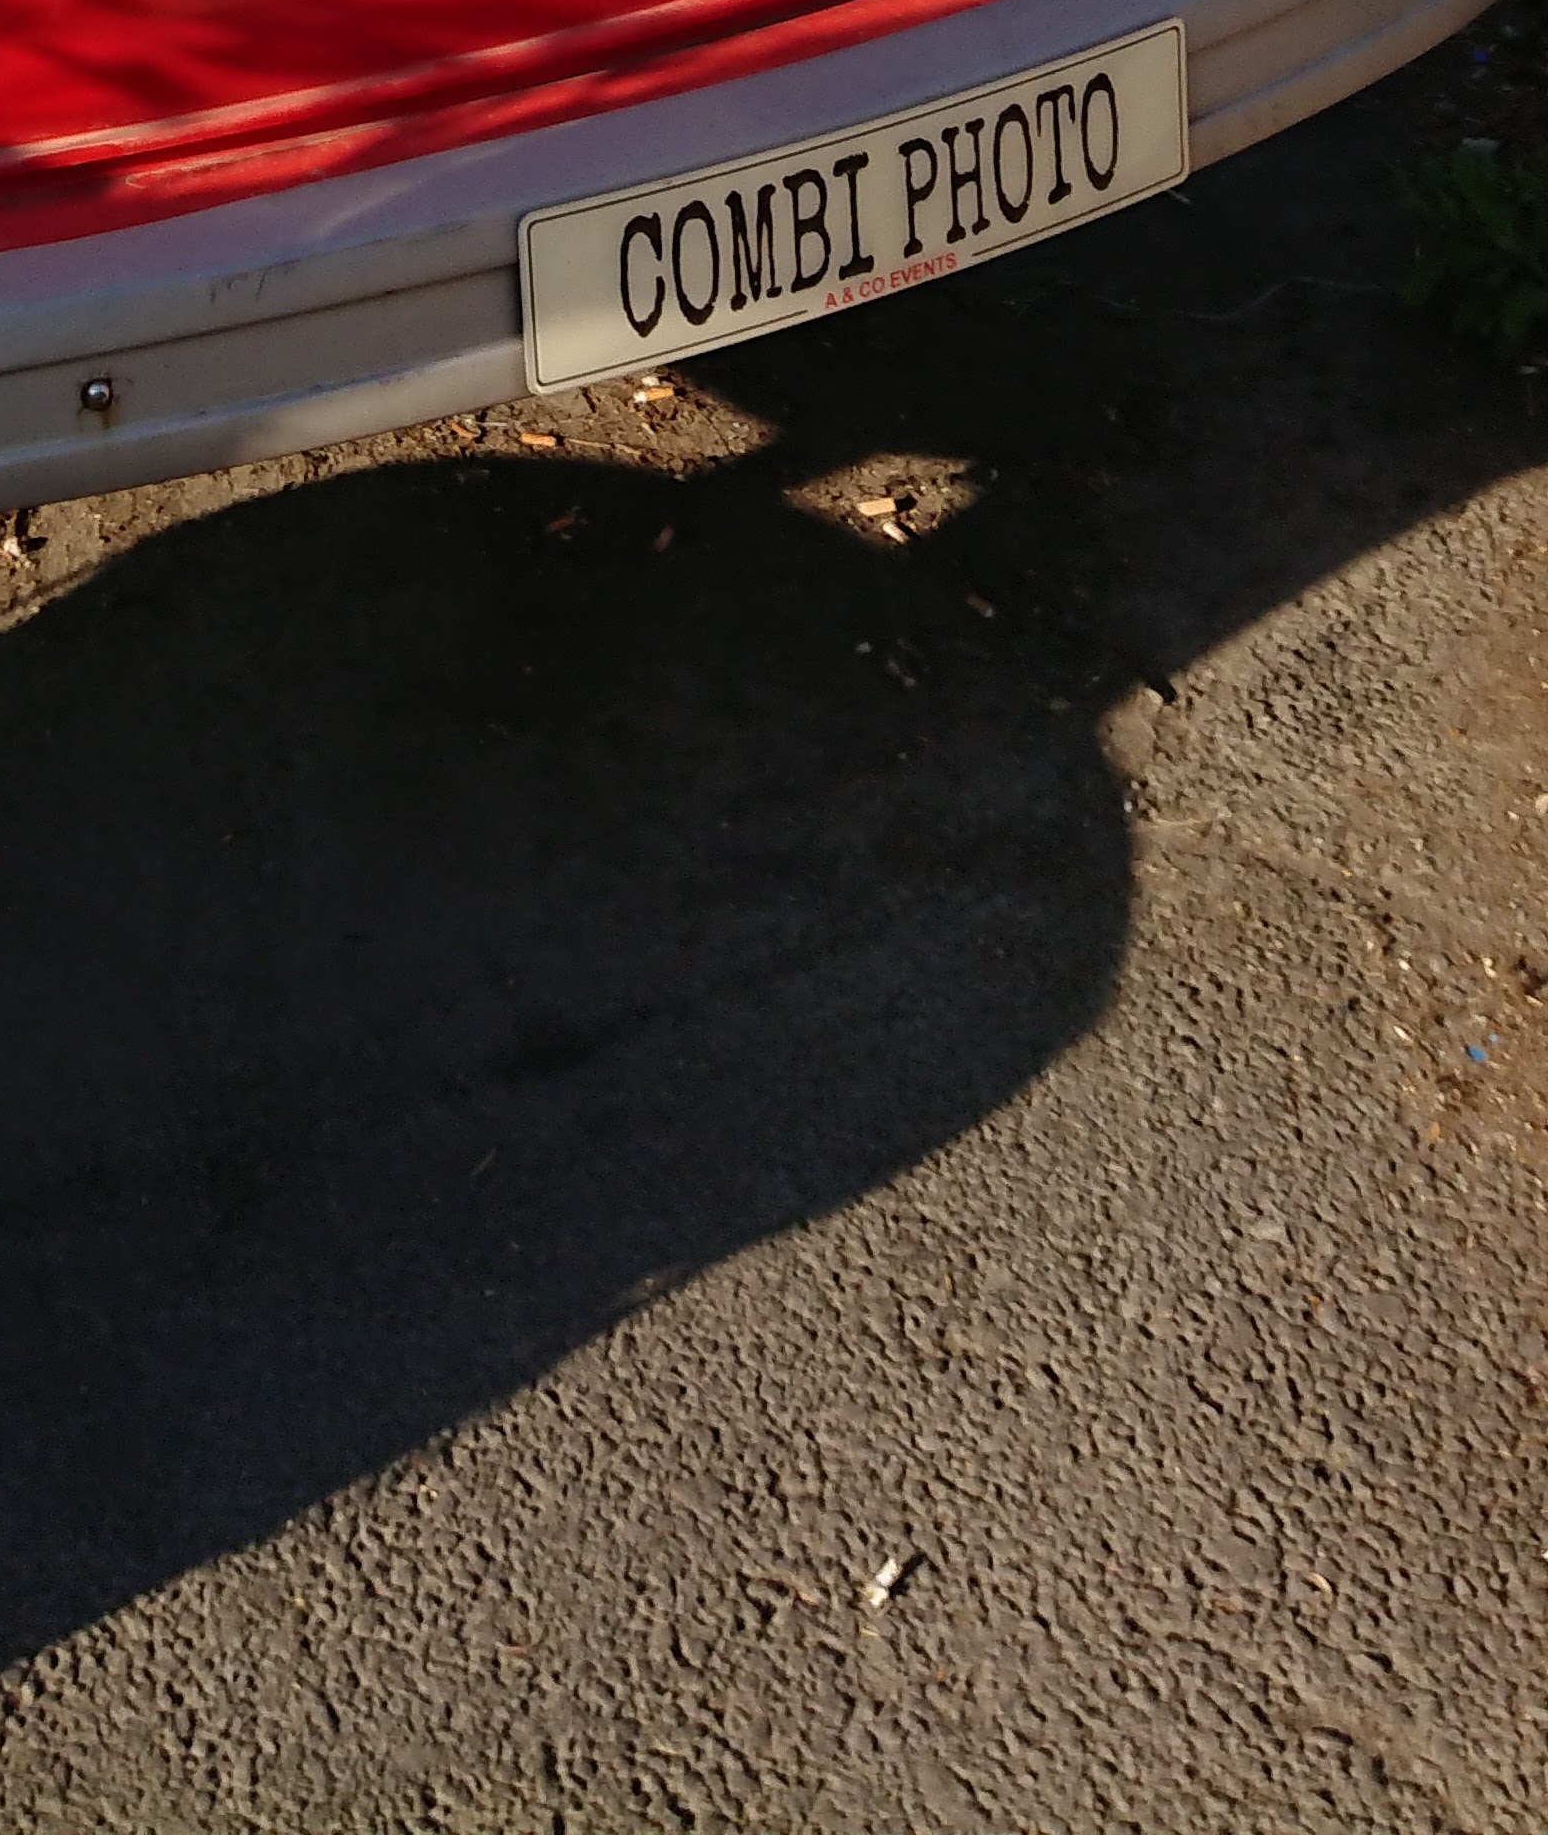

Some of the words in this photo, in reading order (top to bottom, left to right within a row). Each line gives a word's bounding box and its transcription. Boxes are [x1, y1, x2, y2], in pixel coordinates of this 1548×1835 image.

[619, 150, 874, 338] COMBI
[898, 72, 1119, 259] PHOTO
[825, 292, 838, 309] A
[842, 286, 854, 305] &
[859, 276, 886, 298] CO
[889, 252, 958, 289] EVENTS
